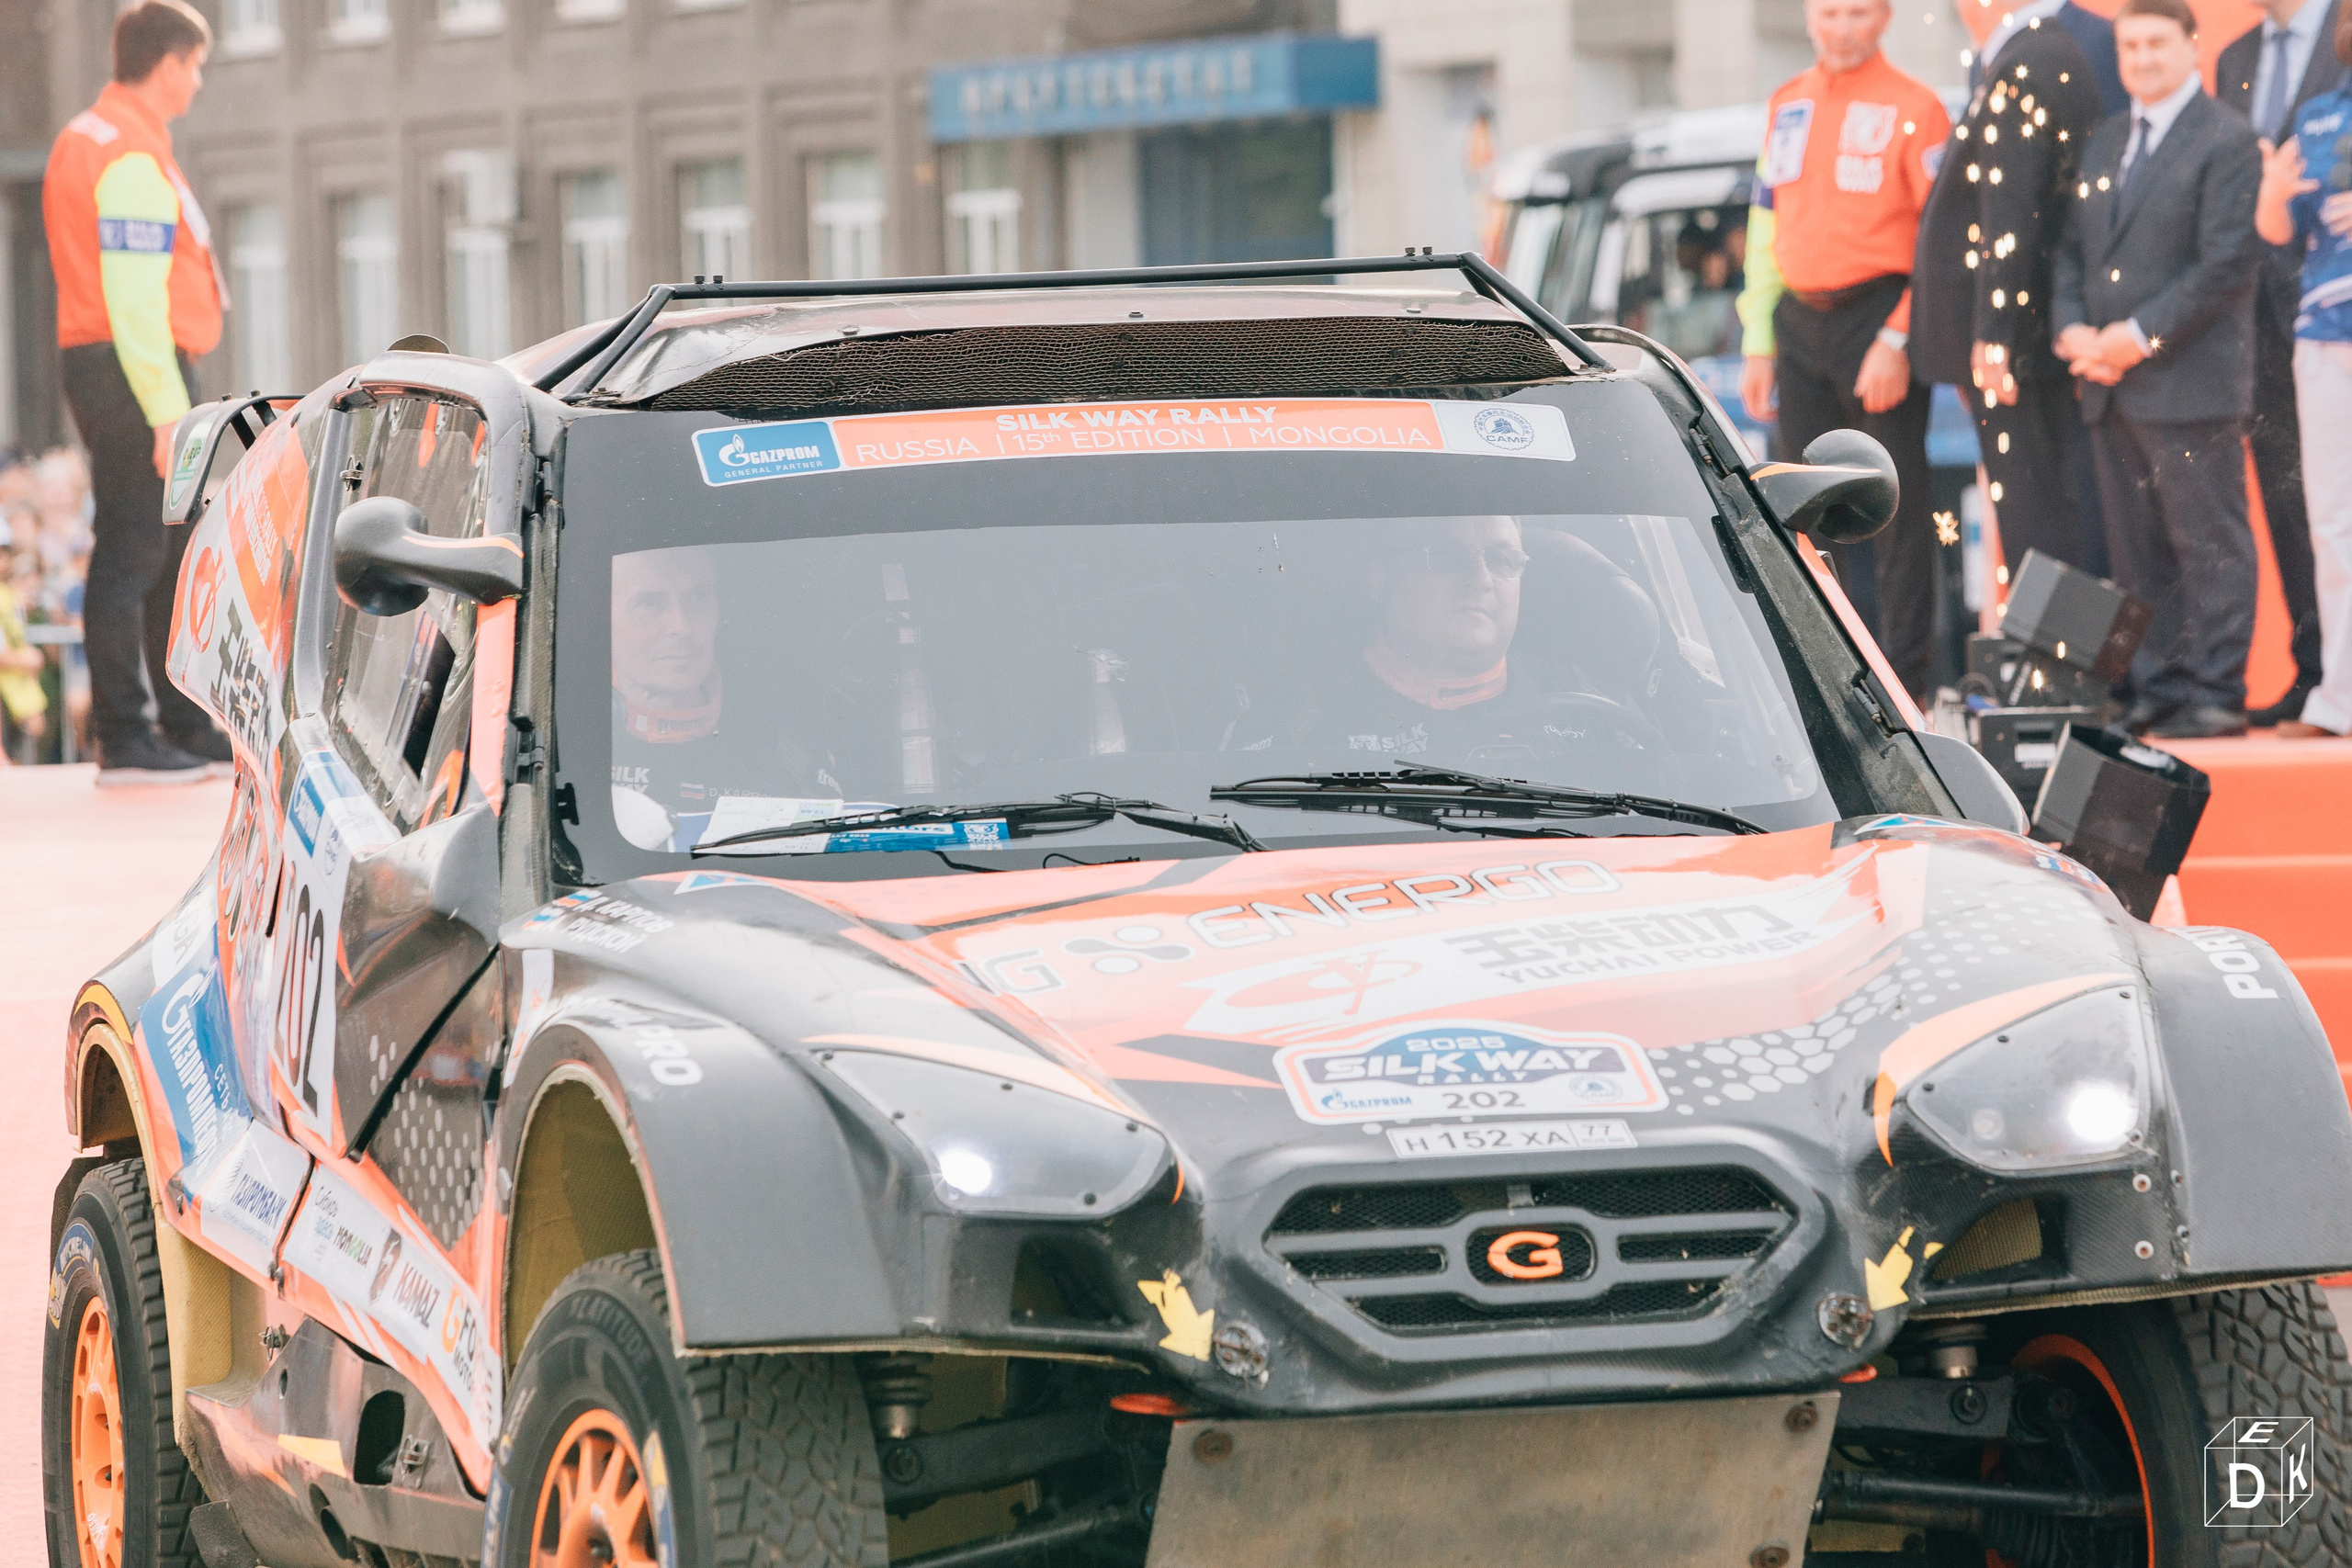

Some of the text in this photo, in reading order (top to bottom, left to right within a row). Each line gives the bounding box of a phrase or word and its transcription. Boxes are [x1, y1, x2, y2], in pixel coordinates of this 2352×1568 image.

[996, 406, 1276, 431] SILK WAY RALLY
[750, 445, 820, 465] GAZPROM
[855, 426, 1431, 462] RUSSIA 15th EDITION MONGOLIA
[1486, 434, 1529, 444] CAMF
[724, 460, 823, 479] GENERAL PARTNER
[1381, 722, 1430, 749] SILK
[597, 899, 675, 933] КАРПОВ
[1187, 859, 1623, 948] ENERGO
[568, 918, 649, 953] РУДСКОЙ
[1442, 904, 1796, 969] 玉柴动力
[1495, 931, 1817, 983] YUCHAI POWER
[1406, 1035, 1506, 1052] 2025
[1324, 1049, 1603, 1081] SILK WAY
[1418, 1072, 1527, 1086] RALLY
[166, 1007, 219, 1178] ГАЗПРОМНЕФТЬ
[213, 1063, 231, 1111] СЕТЬ
[1349, 1096, 1413, 1110] GAZPROM
[1442, 1090, 1525, 1110] 202
[1438, 1129, 1512, 1148] 152
[230, 1173, 288, 1230] ГАЗПРОМБАНК
[1487, 1230, 1564, 1280] G
[392, 1261, 441, 1329] KAMAZ
